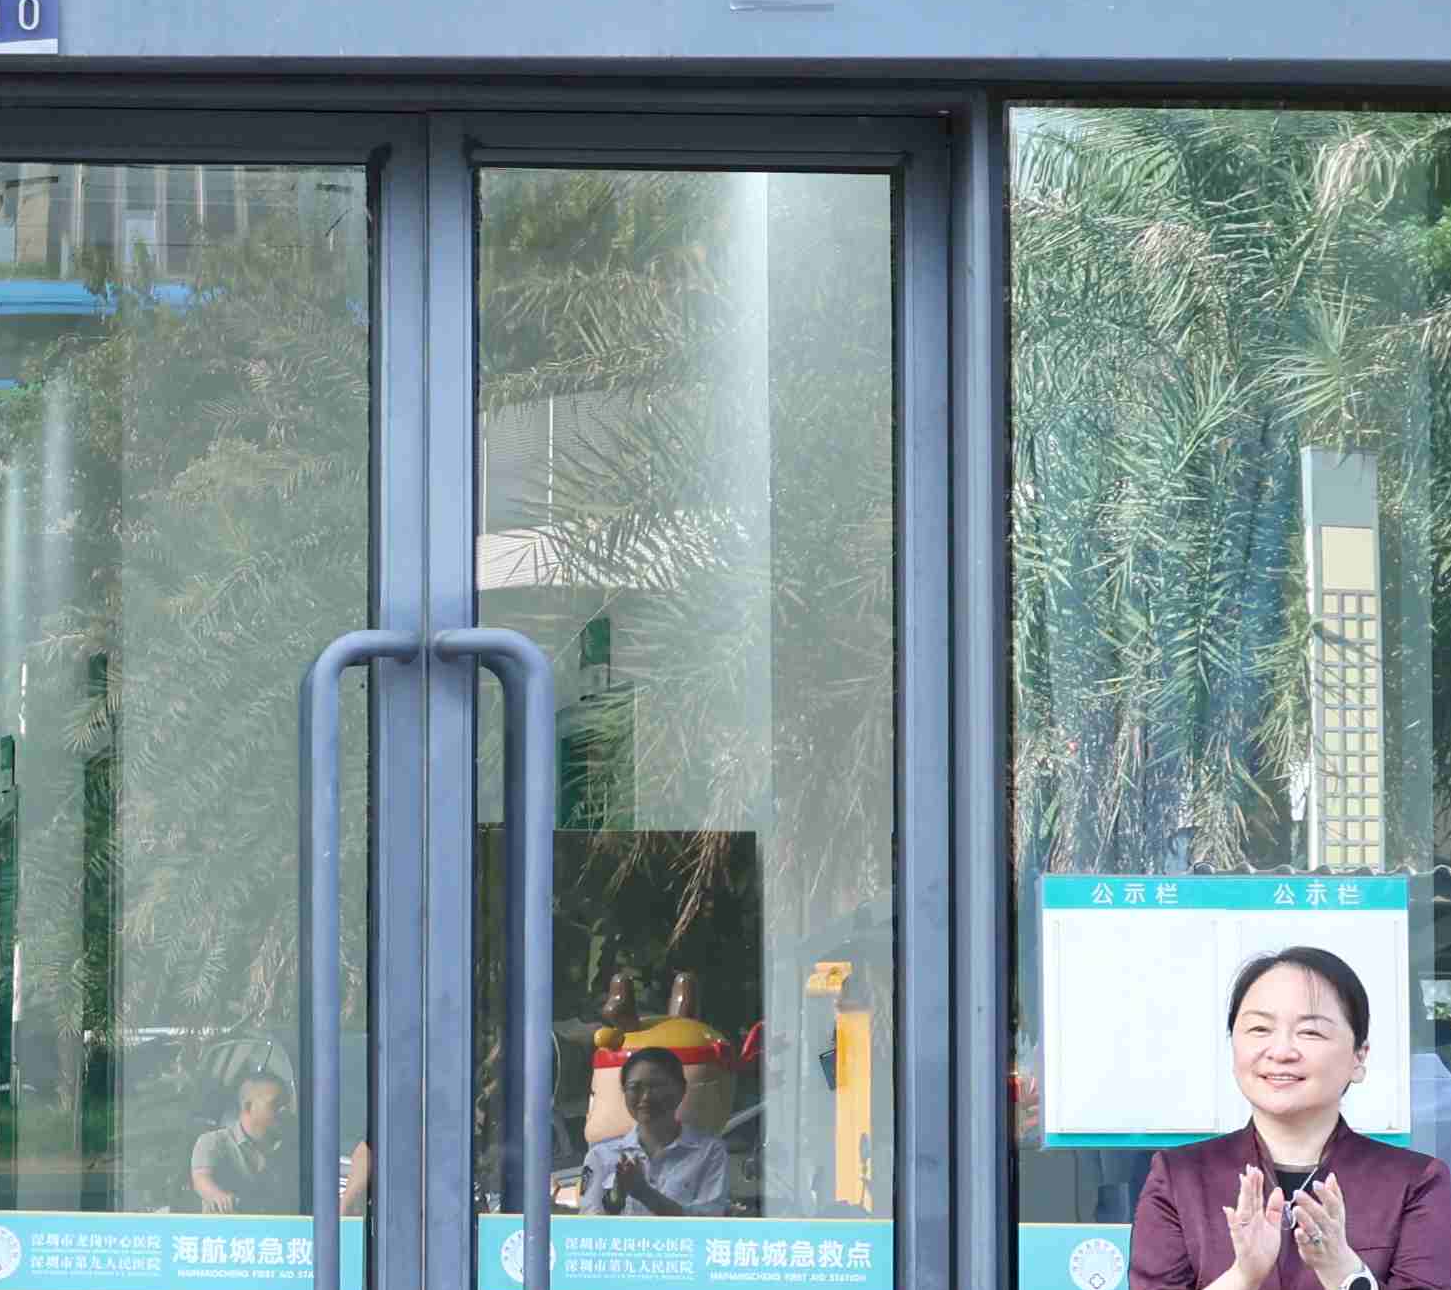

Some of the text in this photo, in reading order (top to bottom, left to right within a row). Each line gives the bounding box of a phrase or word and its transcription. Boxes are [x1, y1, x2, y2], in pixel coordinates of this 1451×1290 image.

[1090, 881, 1179, 906] 公示栏
[1273, 882, 1364, 907] 公示栏
[705, 1238, 873, 1268] 海航城急救点
